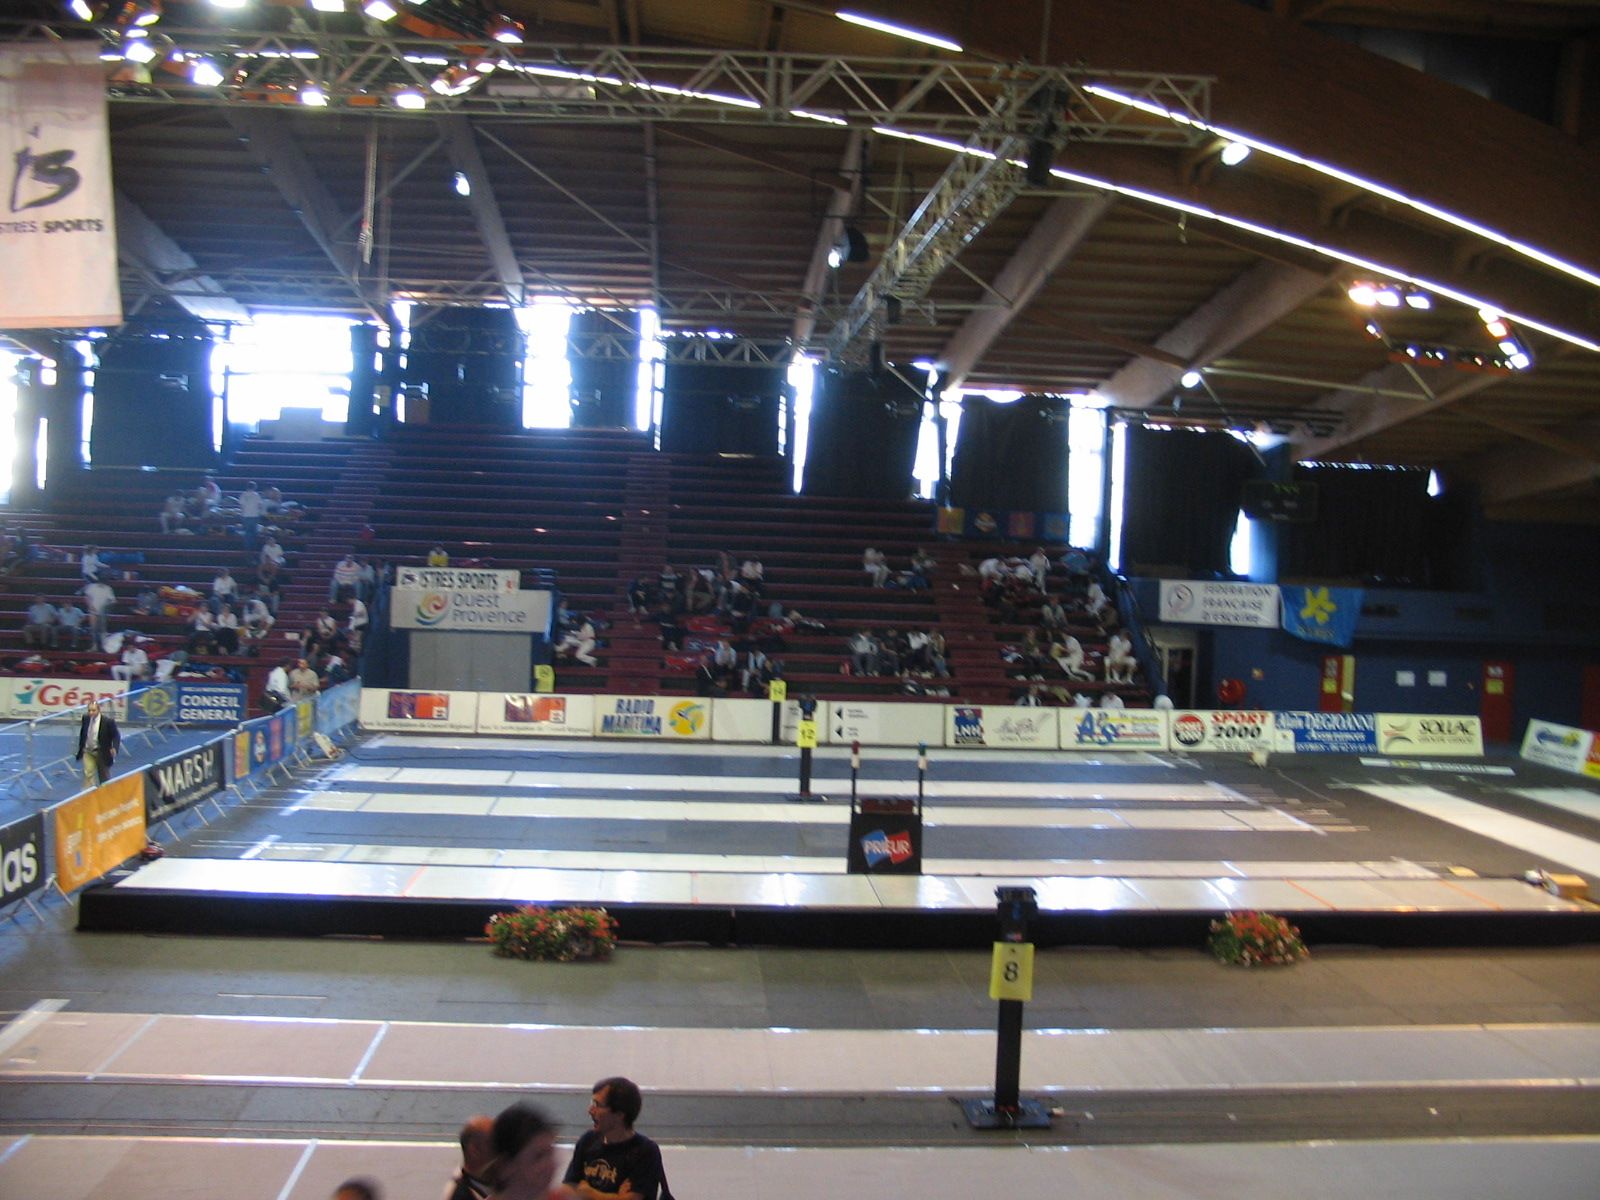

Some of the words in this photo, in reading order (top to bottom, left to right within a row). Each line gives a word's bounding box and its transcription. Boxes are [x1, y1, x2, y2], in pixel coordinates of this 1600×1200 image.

[43, 218, 103, 234] SPORTS
[420, 570, 453, 589] ISTRES
[457, 571, 498, 590] SPORTS
[453, 608, 526, 624] Provence
[38, 684, 124, 708] Géant
[180, 695, 240, 707] CONSEIL
[180, 708, 240, 720] GENERAL
[616, 699, 654, 714] RADIO
[602, 715, 662, 735] MARITIMA
[1211, 711, 1268, 726] SPORT
[1213, 726, 1262, 738] 2000
[158, 748, 214, 798] MARSH
[0, 842, 38, 897] as
[1003, 960, 1019, 983] 8
